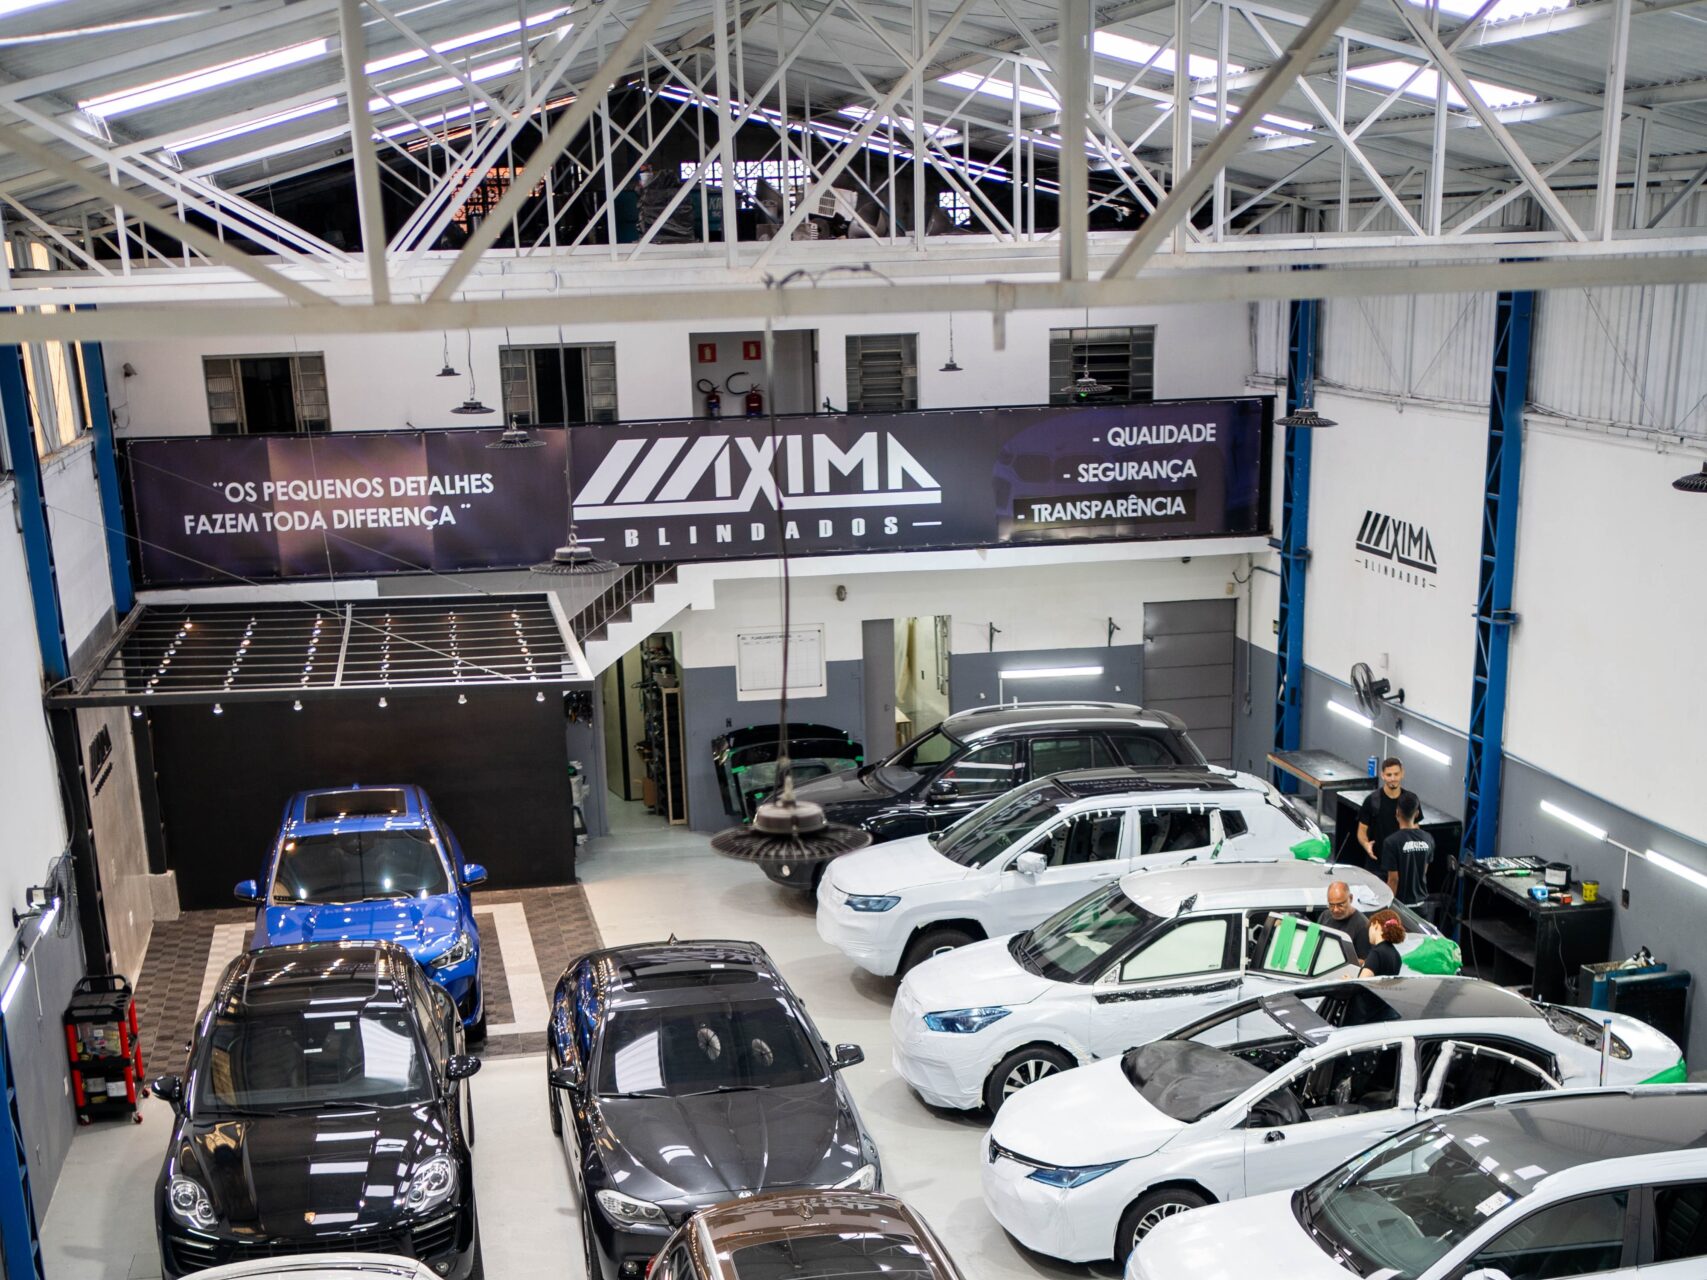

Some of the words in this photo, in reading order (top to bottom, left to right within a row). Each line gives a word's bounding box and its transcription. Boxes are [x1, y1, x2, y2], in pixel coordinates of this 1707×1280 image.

[1107, 423, 1216, 447] QUALIDADE
[1077, 459, 1198, 483] SEGURANÇA
[262, 476, 385, 502] PEQUENOS
[389, 472, 495, 497] DETALHES
[184, 512, 259, 535] FAZEM
[262, 509, 328, 532] TODA
[332, 505, 457, 531] DIFERENÇA
[1030, 494, 1187, 523] TRANSPARÊNCIA
[624, 516, 899, 548] BLINDADOS
